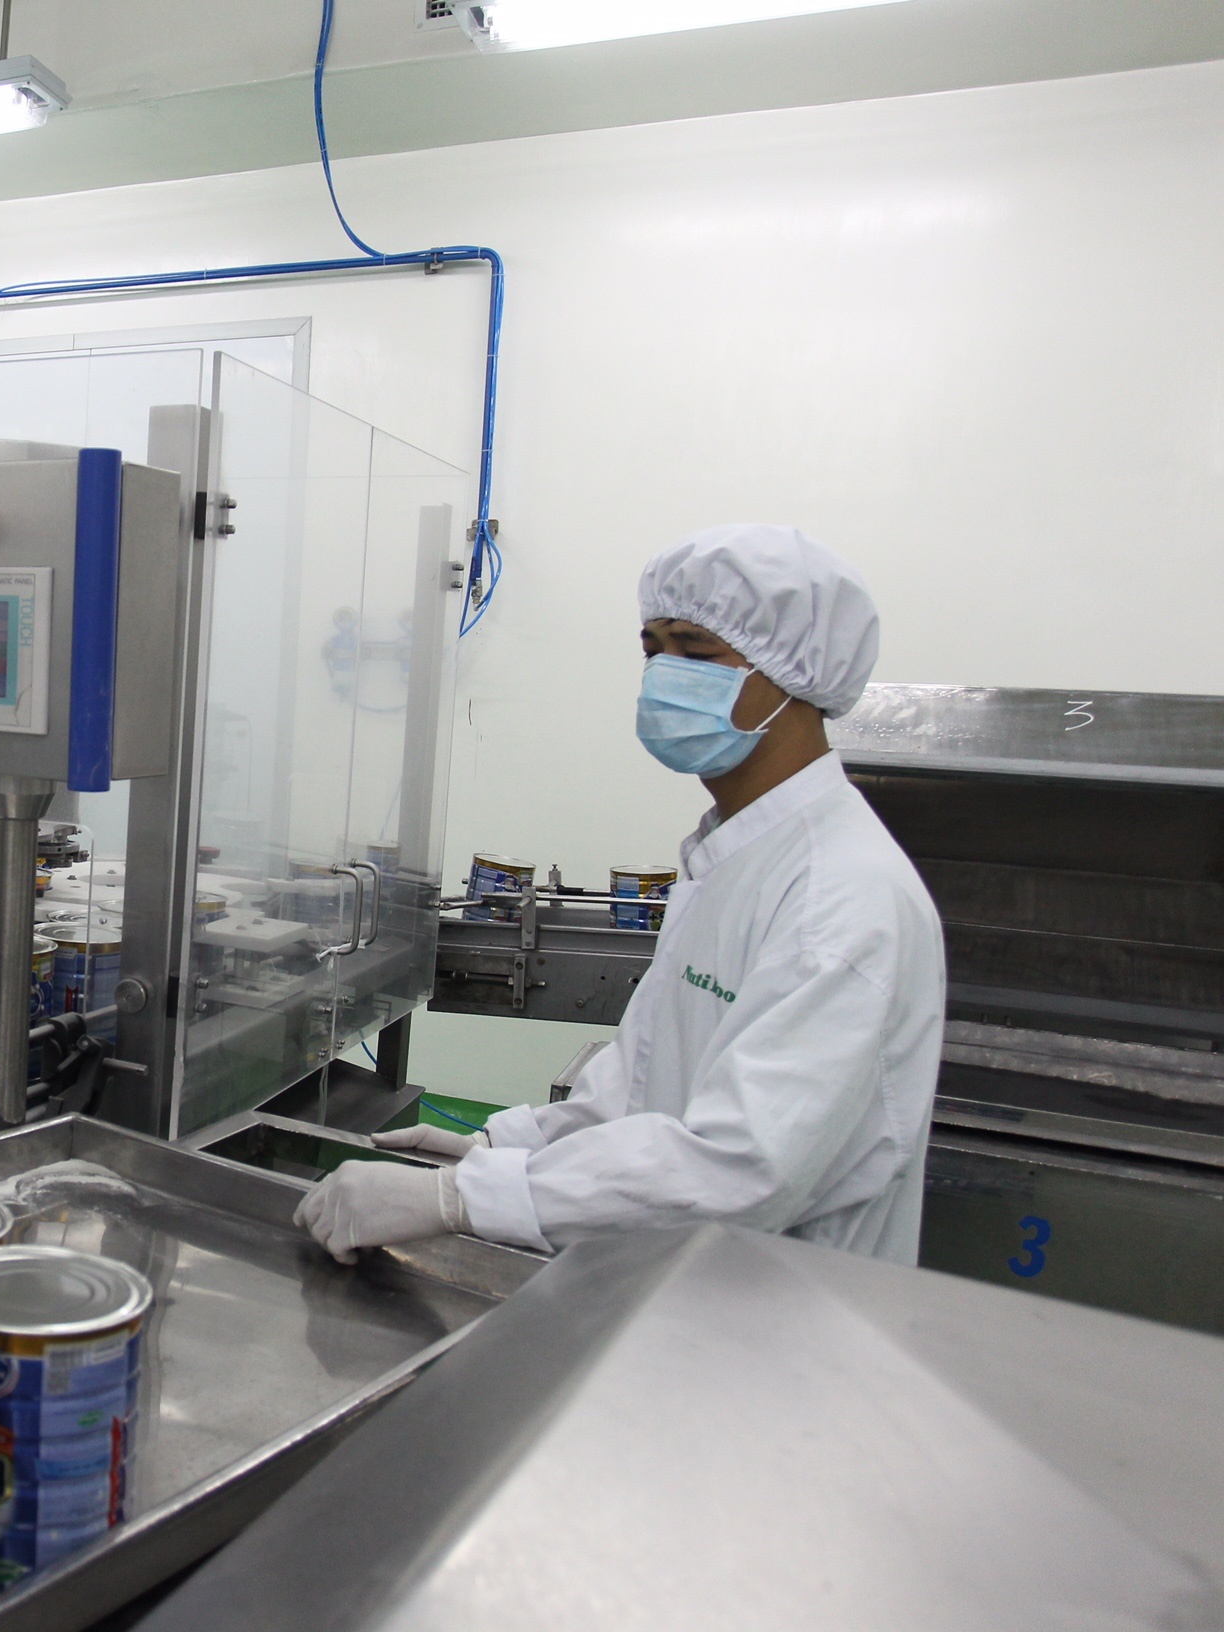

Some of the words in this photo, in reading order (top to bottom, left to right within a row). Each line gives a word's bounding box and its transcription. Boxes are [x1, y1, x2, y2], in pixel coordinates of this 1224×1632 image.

[15, 577, 34, 585] PANEL
[20, 597, 35, 648] TOUCH
[1063, 699, 1095, 731] 3
[1007, 1215, 1051, 1278] 3
